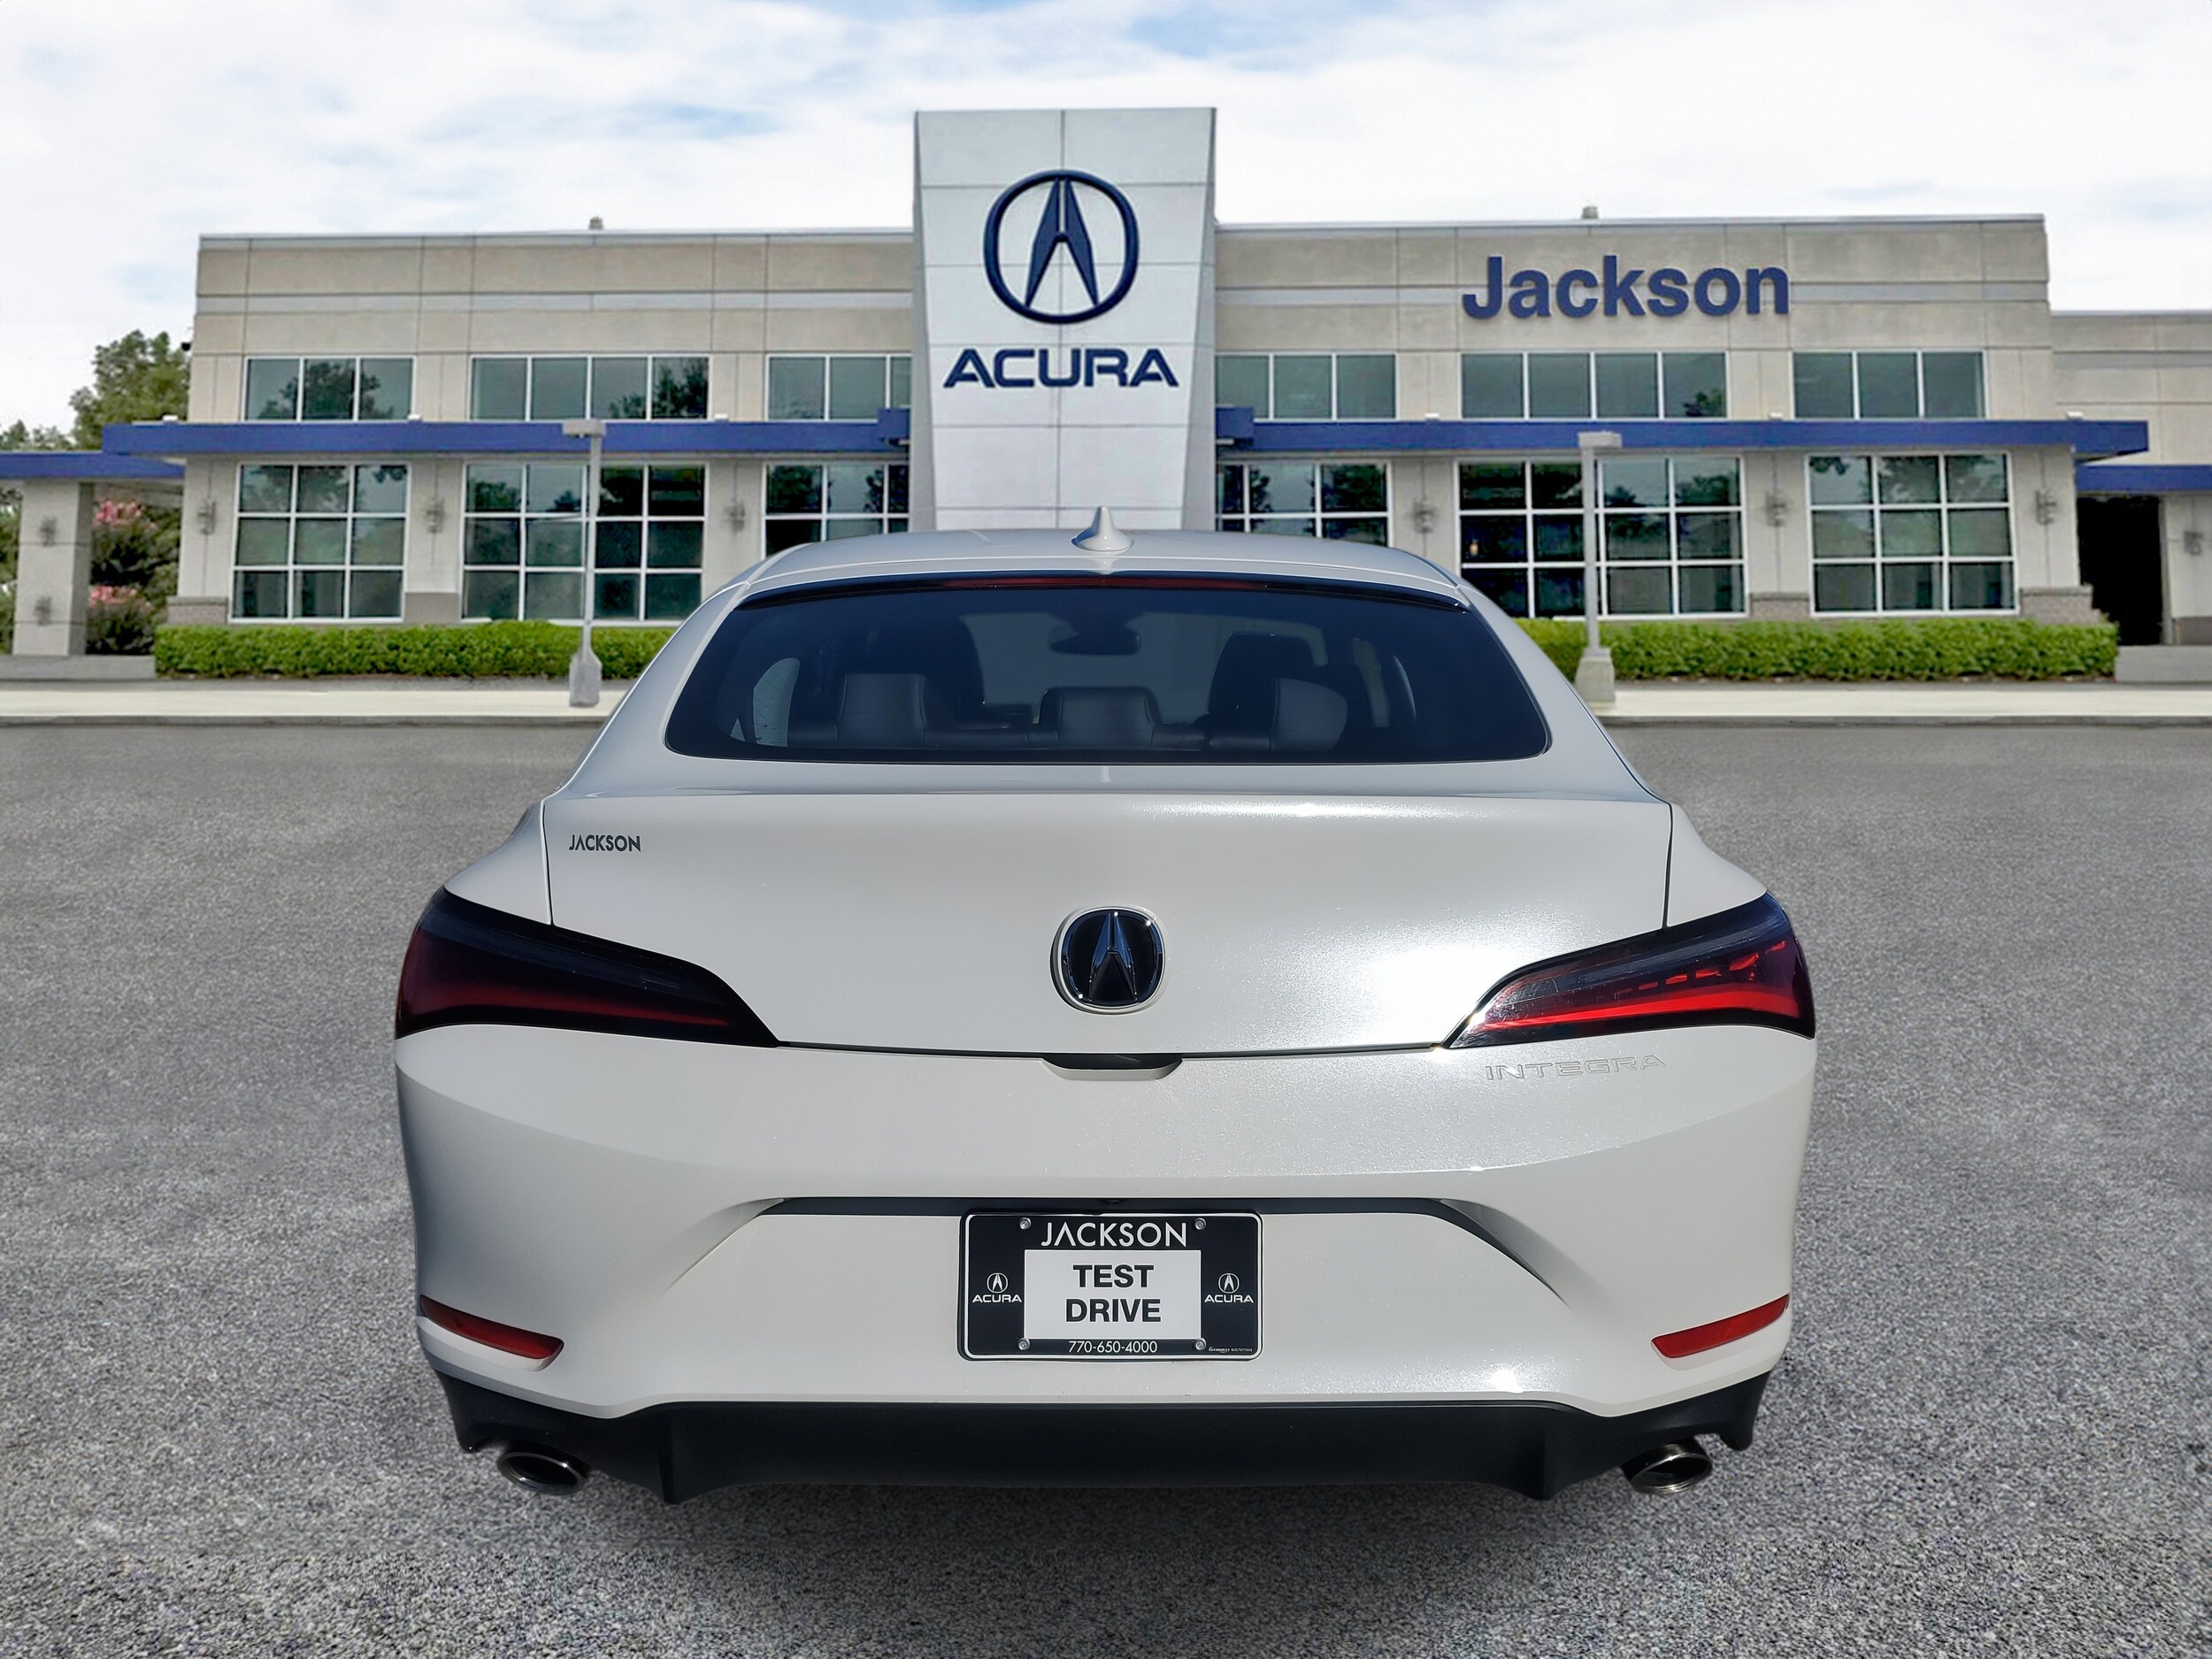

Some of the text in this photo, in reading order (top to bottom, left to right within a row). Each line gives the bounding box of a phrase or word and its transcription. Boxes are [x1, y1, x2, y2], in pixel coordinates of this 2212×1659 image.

[1462, 255, 1790, 319] Jackson
[943, 348, 1179, 388] ACURA
[569, 834, 641, 852] JACKSON
[1486, 1055, 1668, 1080] INTEGRA
[1041, 1222, 1187, 1247] JACKSON
[1072, 1264, 1155, 1288] TEST
[972, 1294, 1022, 1303] ACURA
[1065, 1298, 1162, 1323] DRIVE
[1204, 1294, 1254, 1303] ACURA
[1068, 1340, 1158, 1354] 770-650-4000
